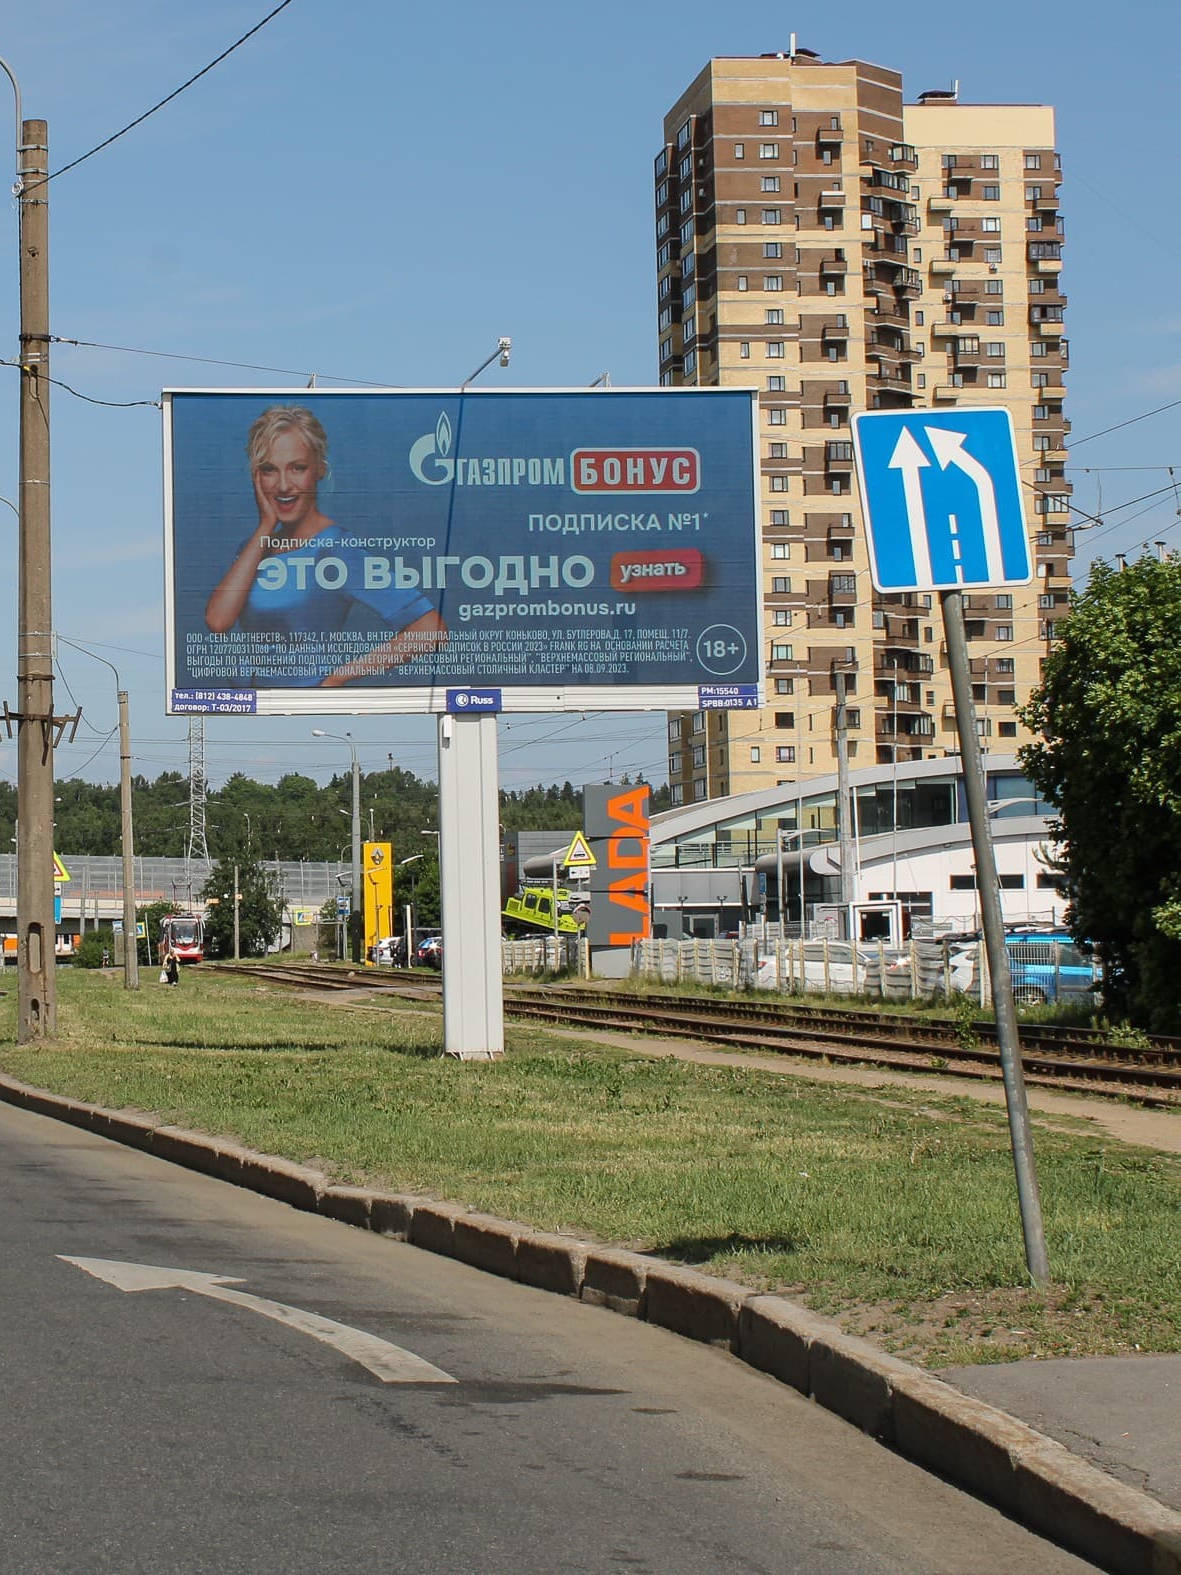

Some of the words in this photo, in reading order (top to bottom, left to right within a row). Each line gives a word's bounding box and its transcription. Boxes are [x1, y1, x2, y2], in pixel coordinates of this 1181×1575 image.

[457, 458, 564, 486] ГАЗПРОМ
[580, 457, 690, 485] БОНУС
[529, 514, 661, 535] ПОДПИСКА
[260, 536, 435, 551] Подписка-конструктор
[257, 557, 348, 590] ЭТО
[364, 555, 595, 596] ВЫГОДНО
[620, 562, 687, 583] узнать
[459, 600, 636, 621] gazprombonus.ru
[186, 633, 203, 643] ООО
[404, 630, 477, 641] МУНИЦИПАЛЬНЫЙ
[479, 630, 503, 641] ОКРУГ
[552, 630, 565, 641] УЛ.
[186, 644, 207, 655] ОГРН
[289, 643, 325, 654] ДАННЫМ
[327, 642, 391, 654] ИССЛЕДОВАНИЯ
[438, 642, 482, 653] ПОДПИСОК
[484, 642, 489, 652] В
[491, 642, 523, 652] РОССИИ
[549, 641, 576, 651] FRANK
[577, 641, 588, 651] RG
[591, 641, 601, 651] НА
[605, 641, 653, 651] ОСНОВАНИИ
[655, 640, 689, 650] РАСЧЕТА
[703, 640, 739, 658] 18+
[187, 655, 223, 666] ВЫГОДЫ
[225, 655, 237, 665] ПО
[239, 655, 296, 665] НАПОЛНЕНИЮ
[298, 654, 343, 666] ПОДПИСОК
[346, 654, 351, 665] В
[353, 654, 404, 664] КАТЕГОРИЯХ
[240, 666, 317, 677] ВЕРХНЕМАССОВЫЙ
[477, 663, 527, 674] СТОЛИЧНЫЙ
[572, 663, 582, 673] НА
[195, 691, 215, 701] (812)
[216, 692, 253, 701] 438-4848
[470, 695, 493, 705] Russ
[174, 704, 210, 712] договор:
[607, 785, 651, 946] LADA
